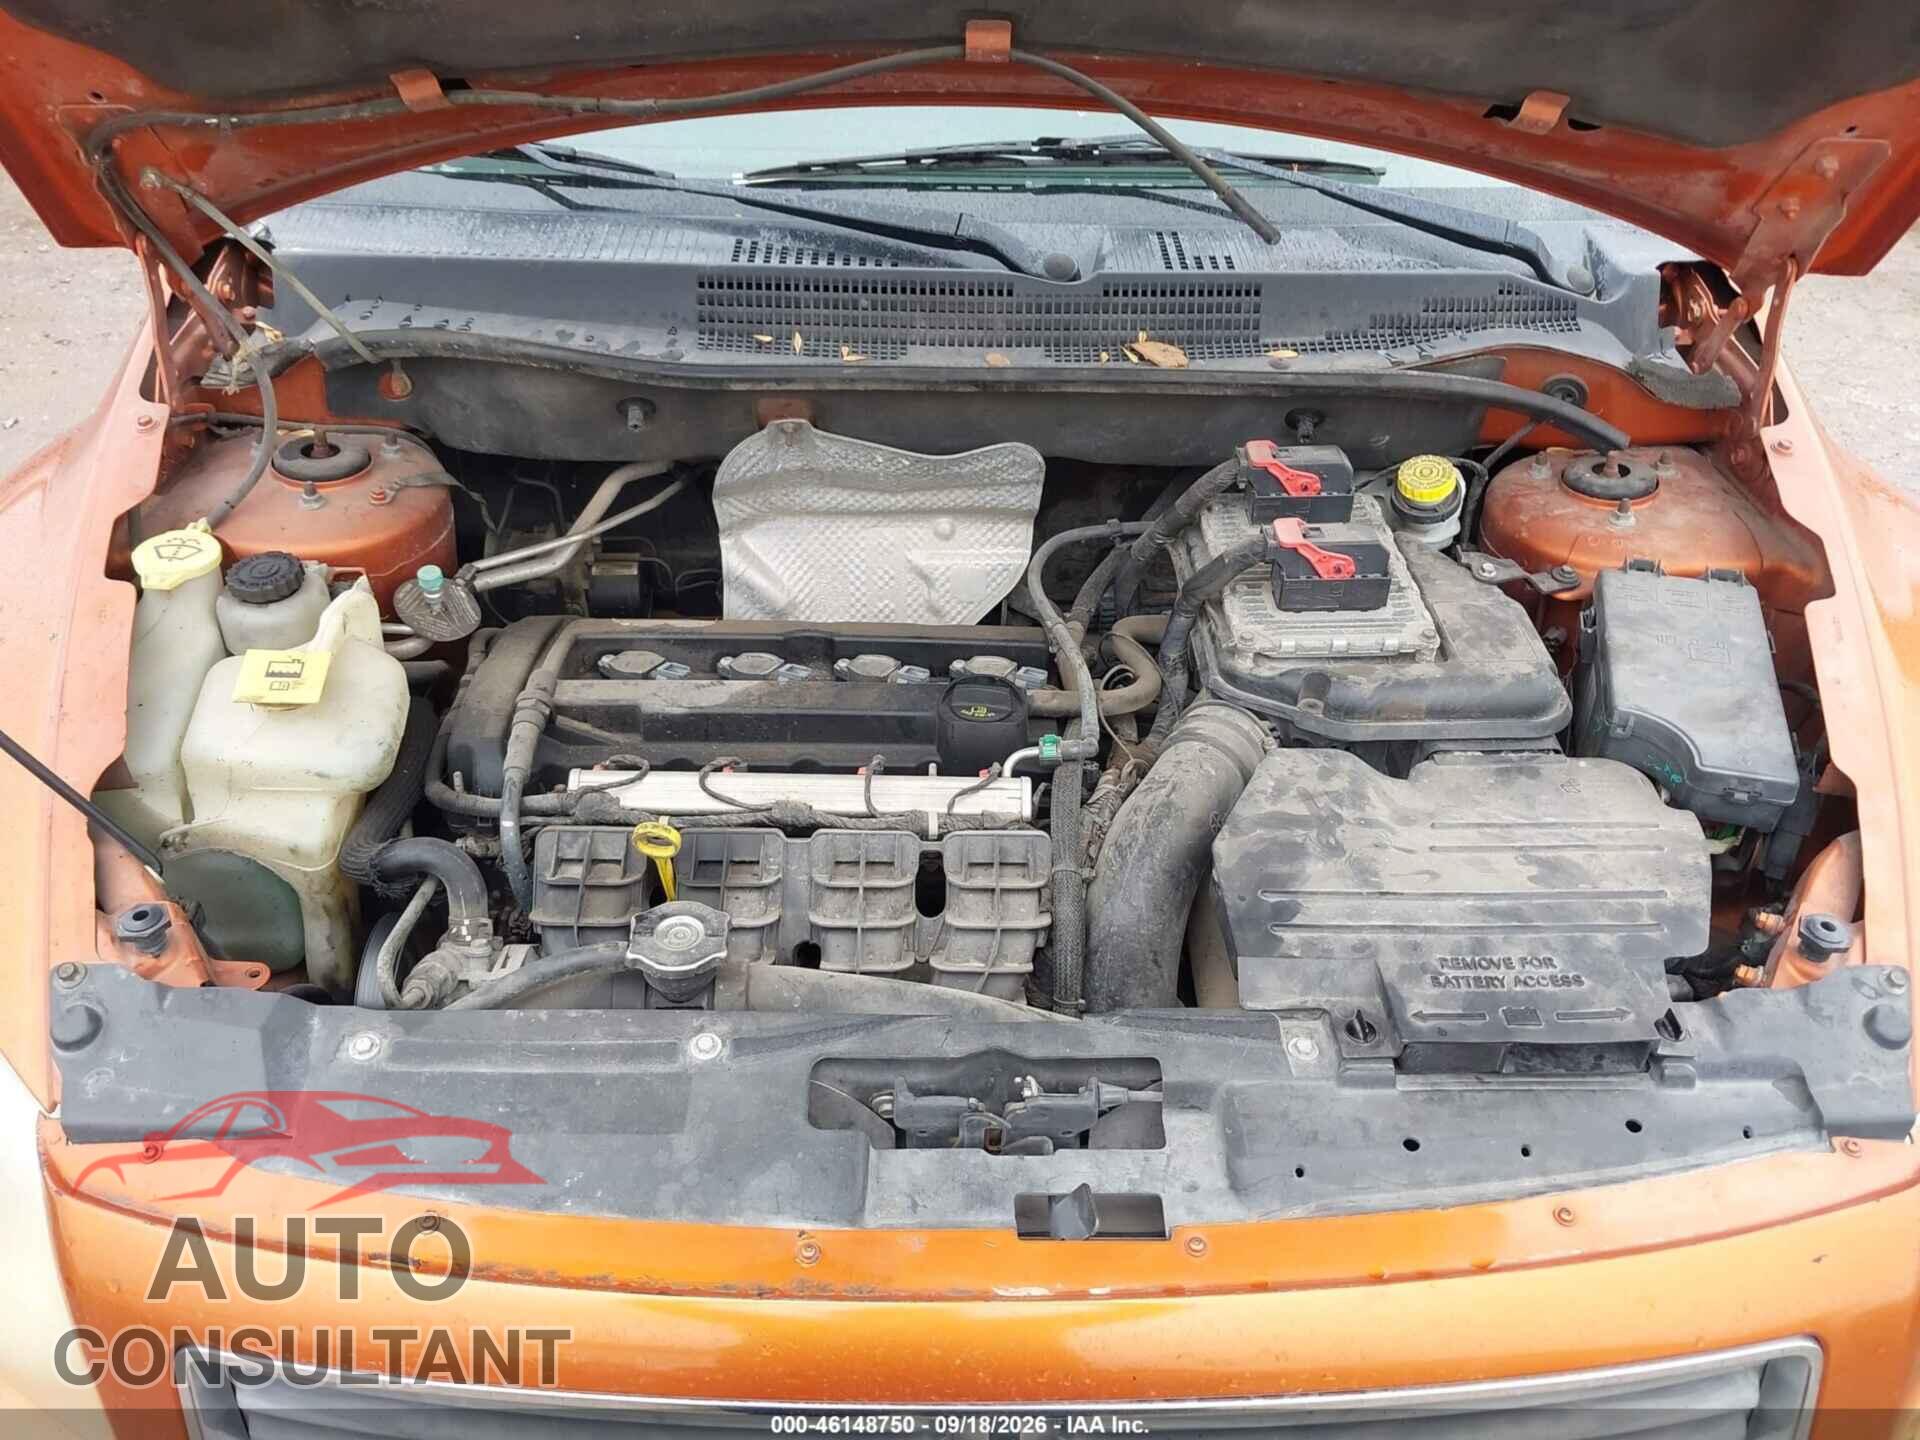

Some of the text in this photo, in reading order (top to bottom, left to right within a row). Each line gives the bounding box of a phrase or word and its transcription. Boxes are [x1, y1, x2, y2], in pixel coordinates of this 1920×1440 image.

[1437, 955, 1558, 970] REMOVE FOR
[1430, 974, 1585, 989] BATTERY ACCESS
